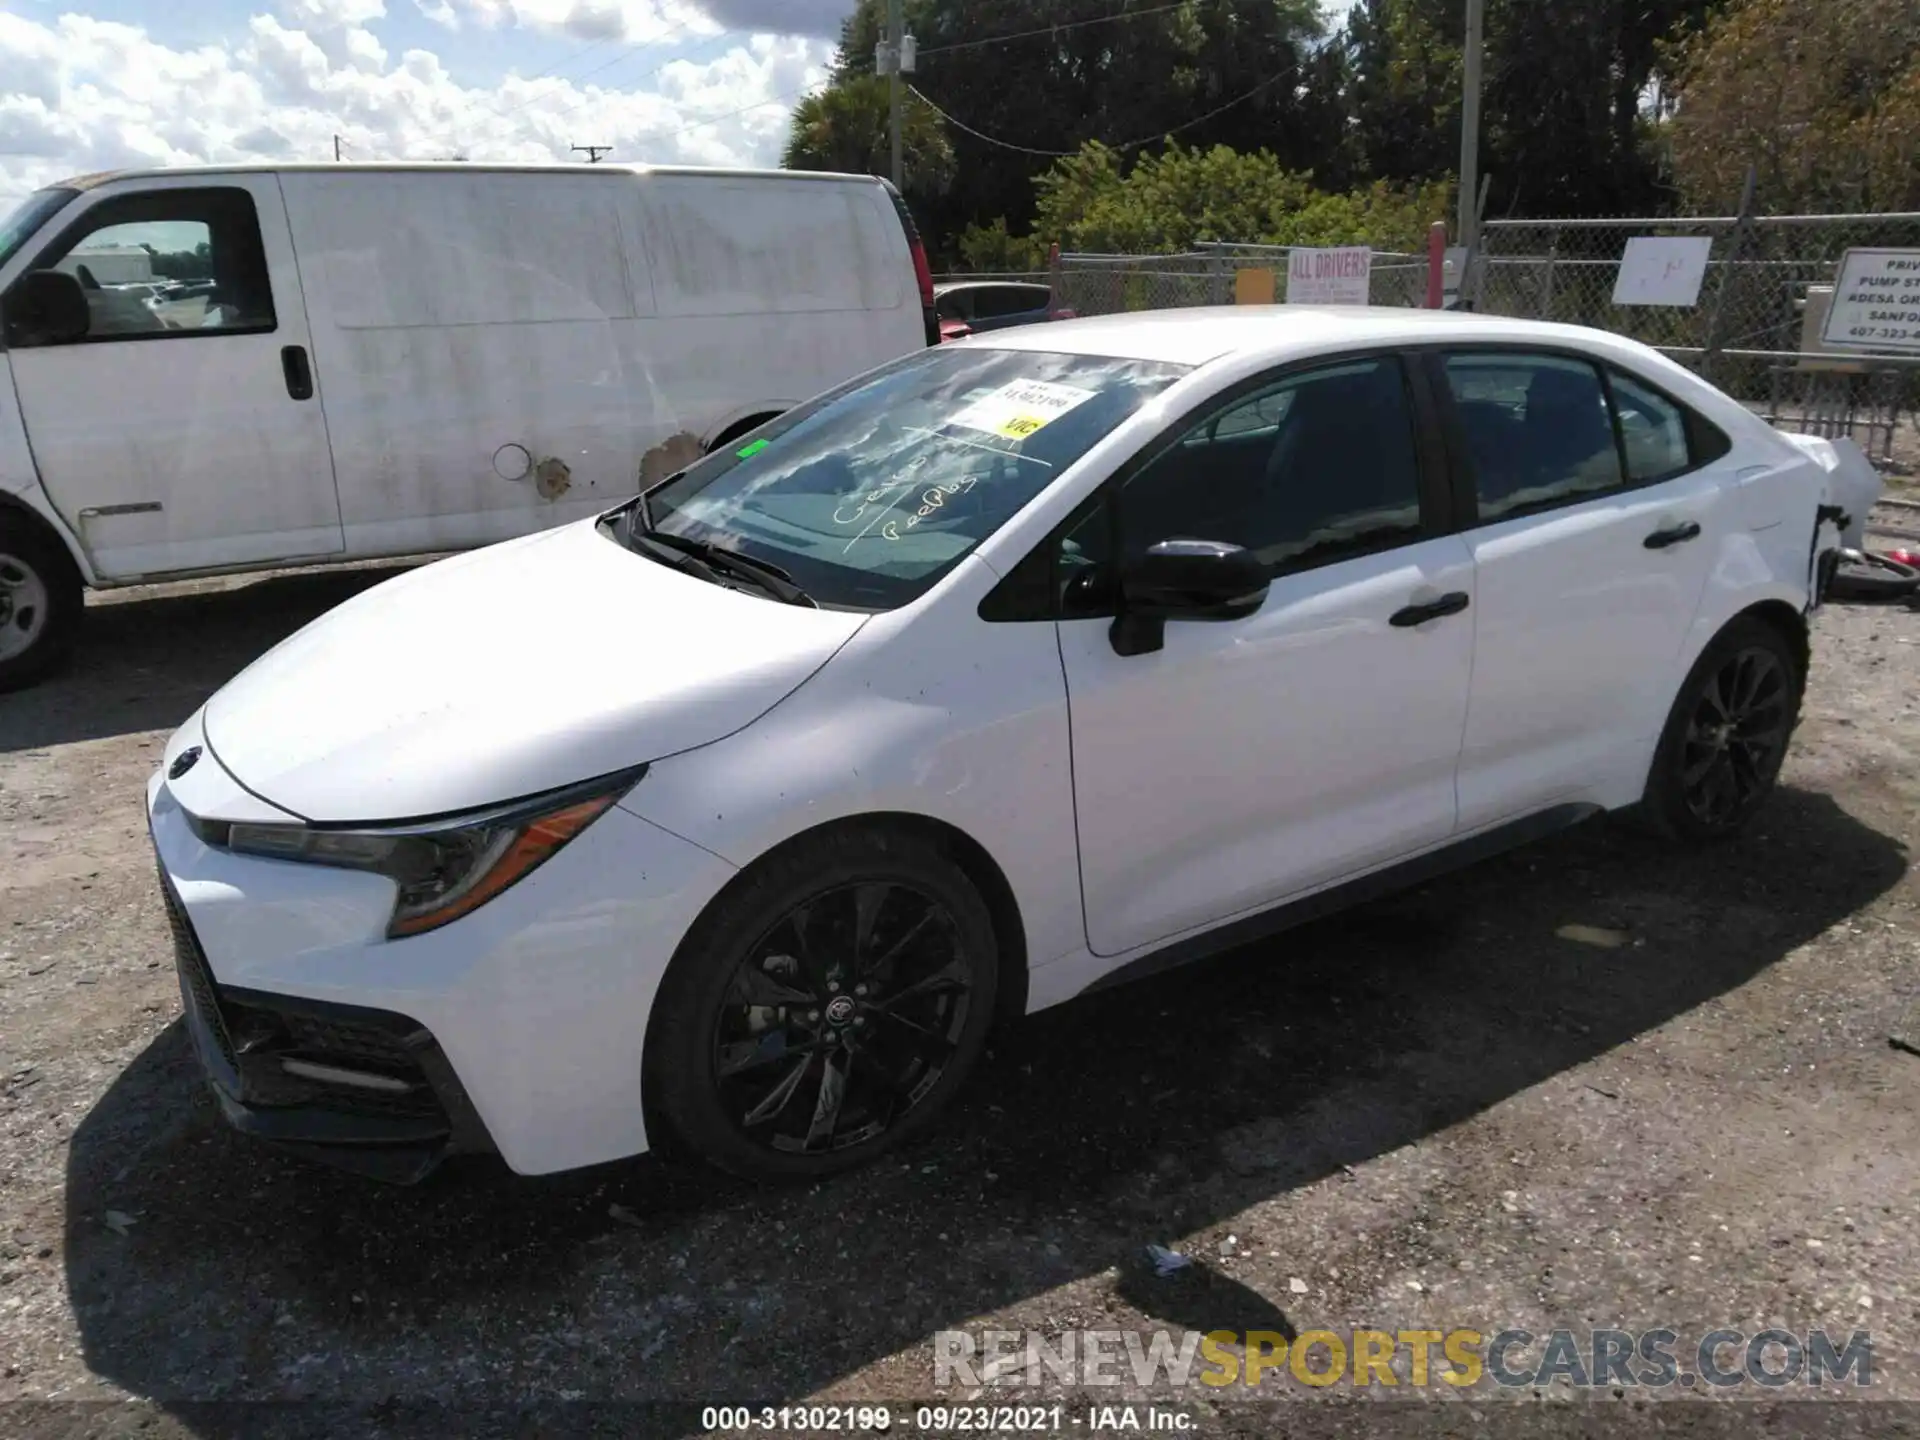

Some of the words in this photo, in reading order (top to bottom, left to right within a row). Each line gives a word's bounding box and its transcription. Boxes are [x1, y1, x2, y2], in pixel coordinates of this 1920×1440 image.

[1291, 255, 1312, 279] ALL
[1316, 252, 1368, 278] DRIVERS
[1859, 276, 1899, 286] PUMP
[1848, 293, 1895, 303] ADESA
